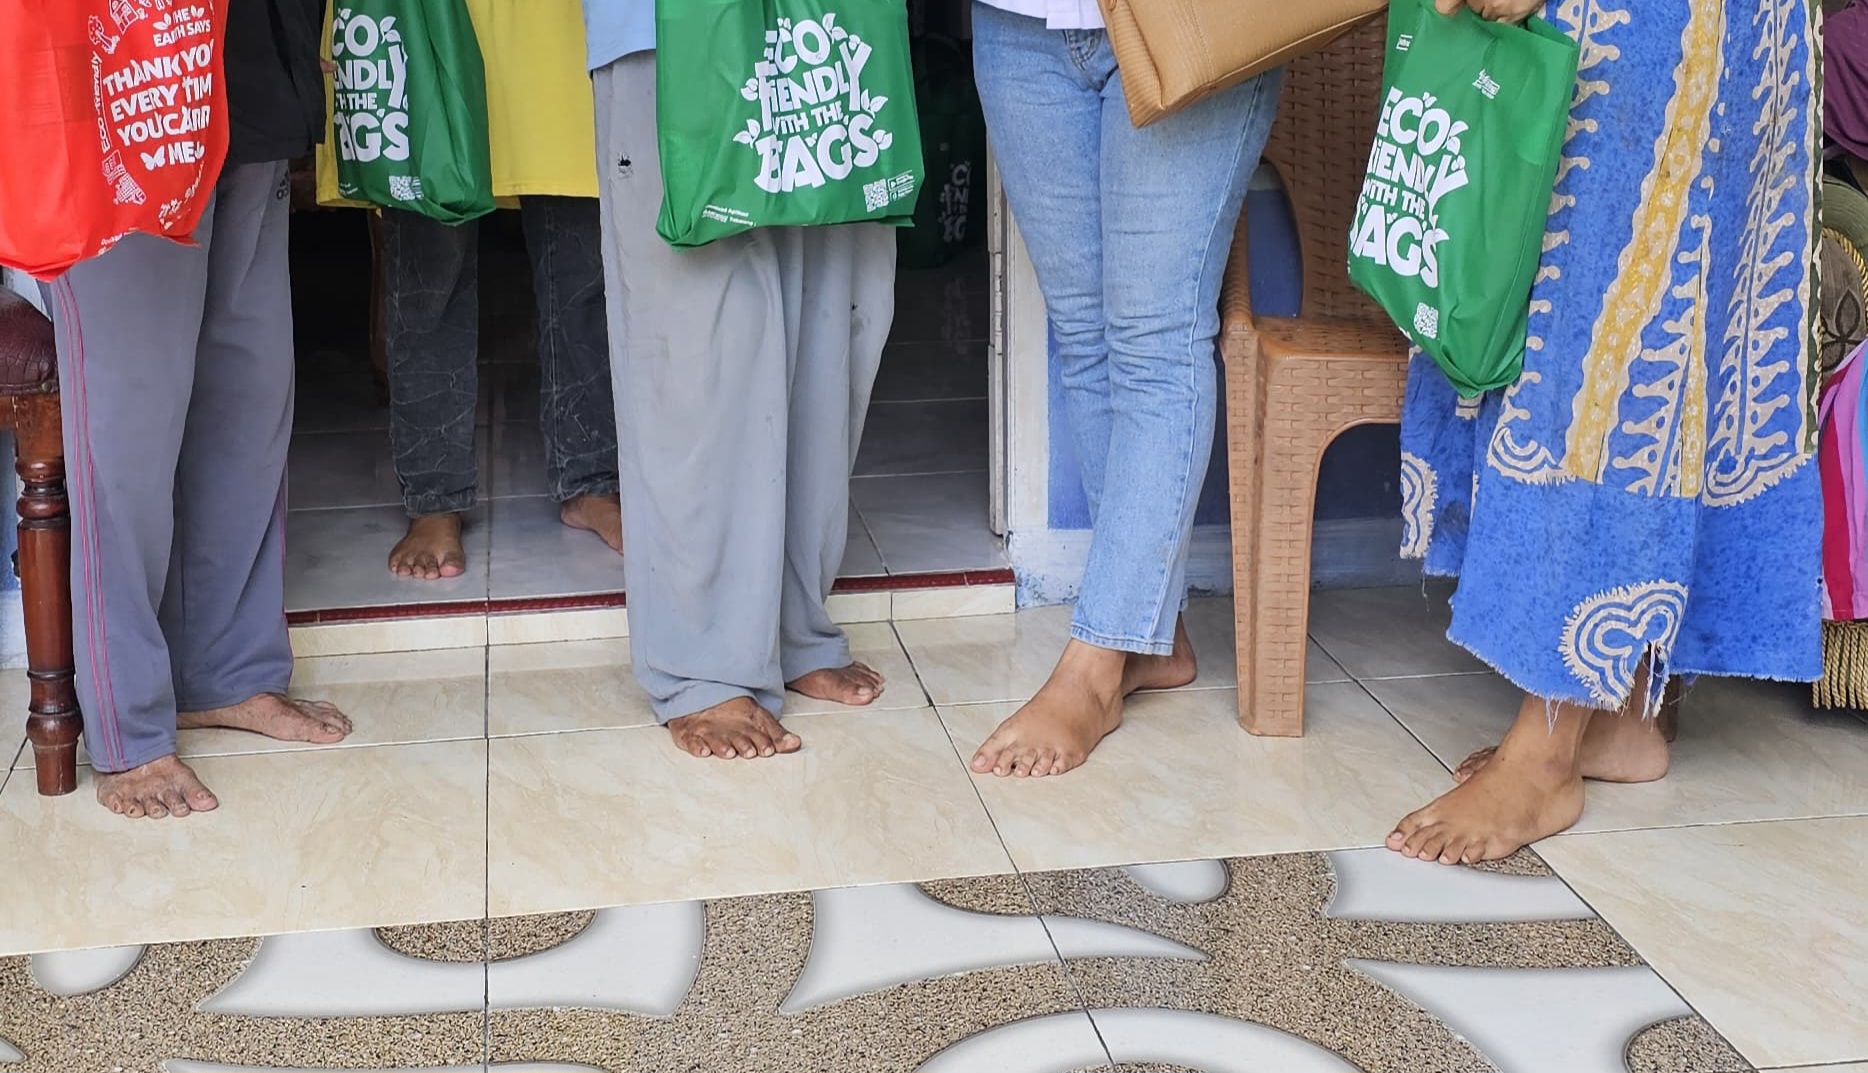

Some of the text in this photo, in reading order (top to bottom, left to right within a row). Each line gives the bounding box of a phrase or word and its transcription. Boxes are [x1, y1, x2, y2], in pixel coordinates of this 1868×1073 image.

[187, 19, 211, 36] SAYS
[332, 14, 379, 57] CO
[103, 39, 214, 96] THANK YO
[110, 72, 212, 123] EVERY TIM
[347, 92, 378, 110] THE
[811, 100, 844, 127] THE
[117, 110, 164, 146] YOU
[1377, 86, 1451, 156] ECO
[168, 141, 196, 165] ME
[753, 114, 879, 193] BAGS
[1401, 190, 1426, 219] THE
[1351, 198, 1450, 289] AGS
